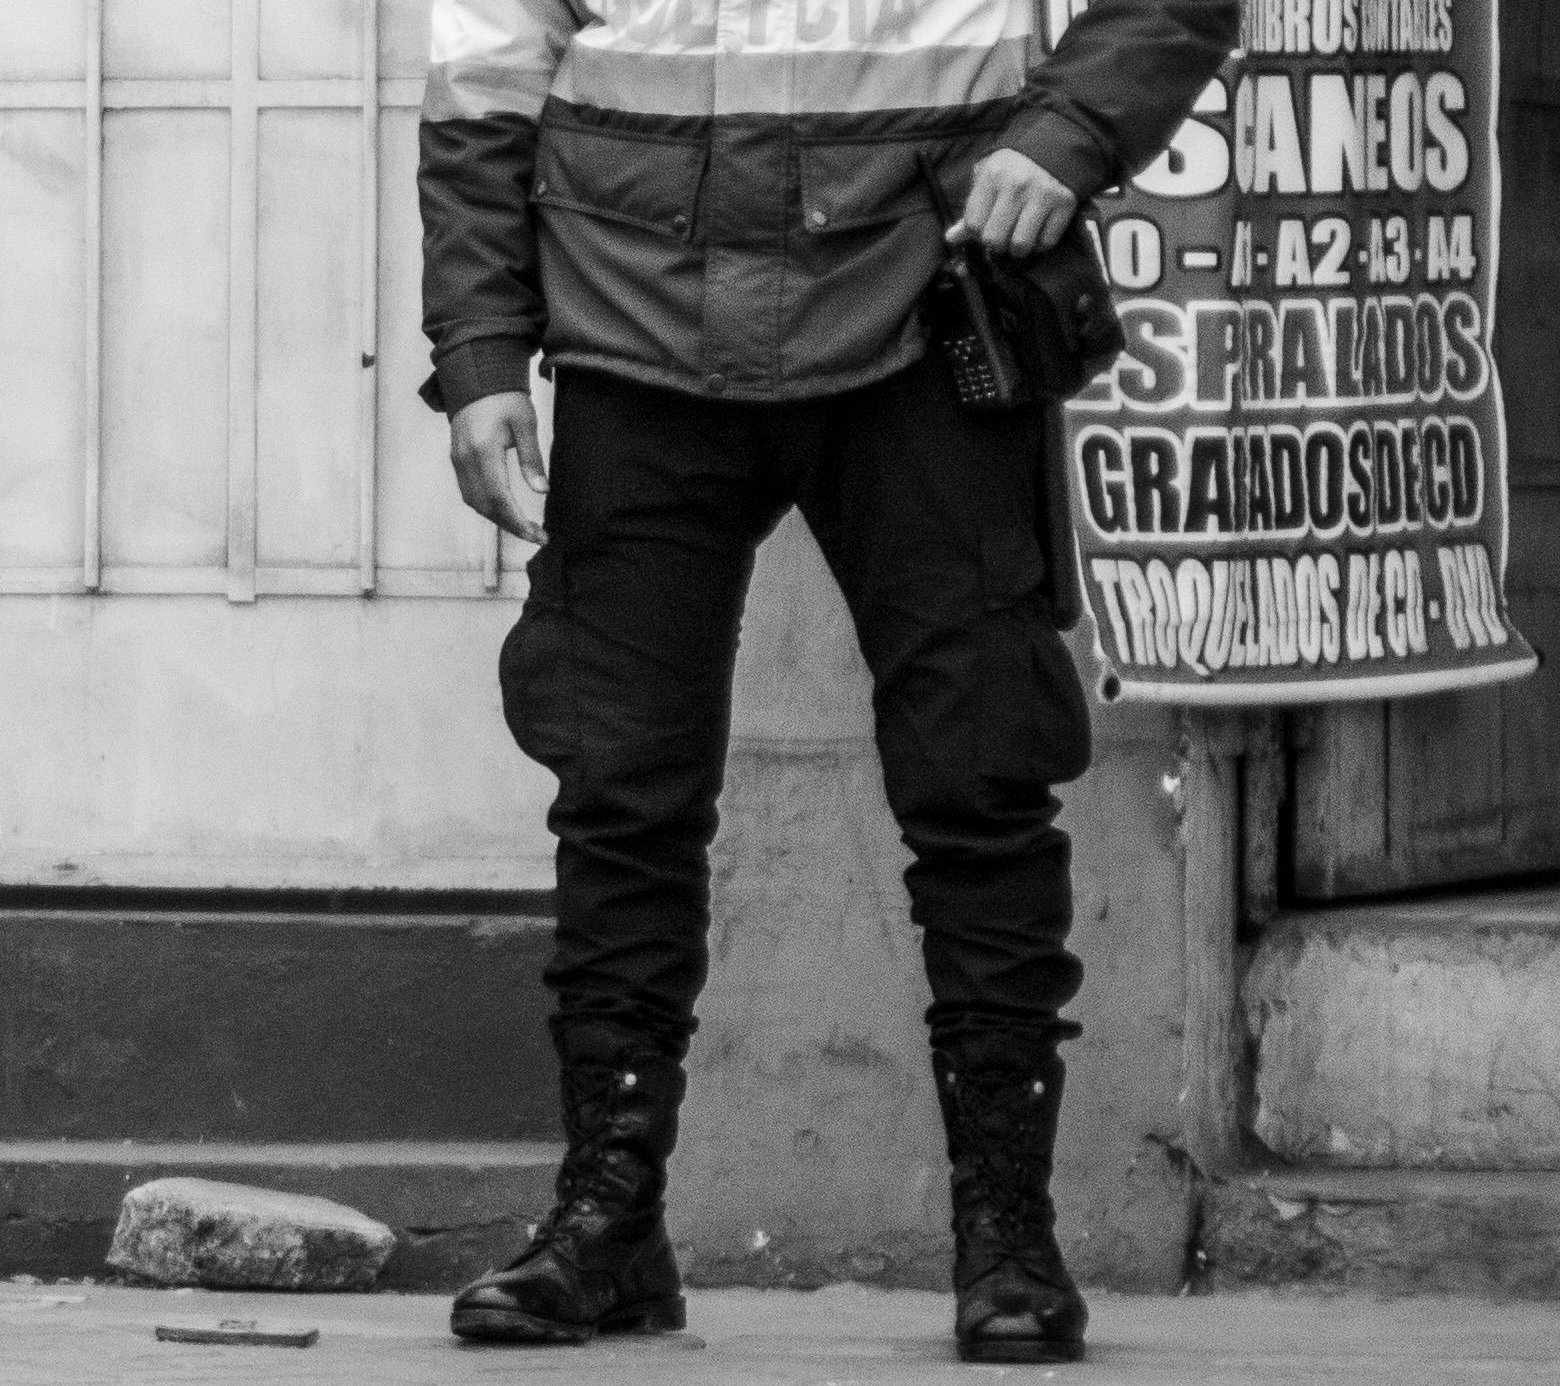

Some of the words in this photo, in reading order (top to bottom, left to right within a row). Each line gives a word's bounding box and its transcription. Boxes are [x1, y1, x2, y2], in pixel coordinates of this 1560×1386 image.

[1115, 72, 1470, 197] SCANEOS
[1275, 218, 1352, 286] A2
[1369, 216, 1411, 284] A3
[1426, 215, 1477, 281] A4
[1421, 416, 1484, 529] CD
[1383, 549, 1429, 657] CD
